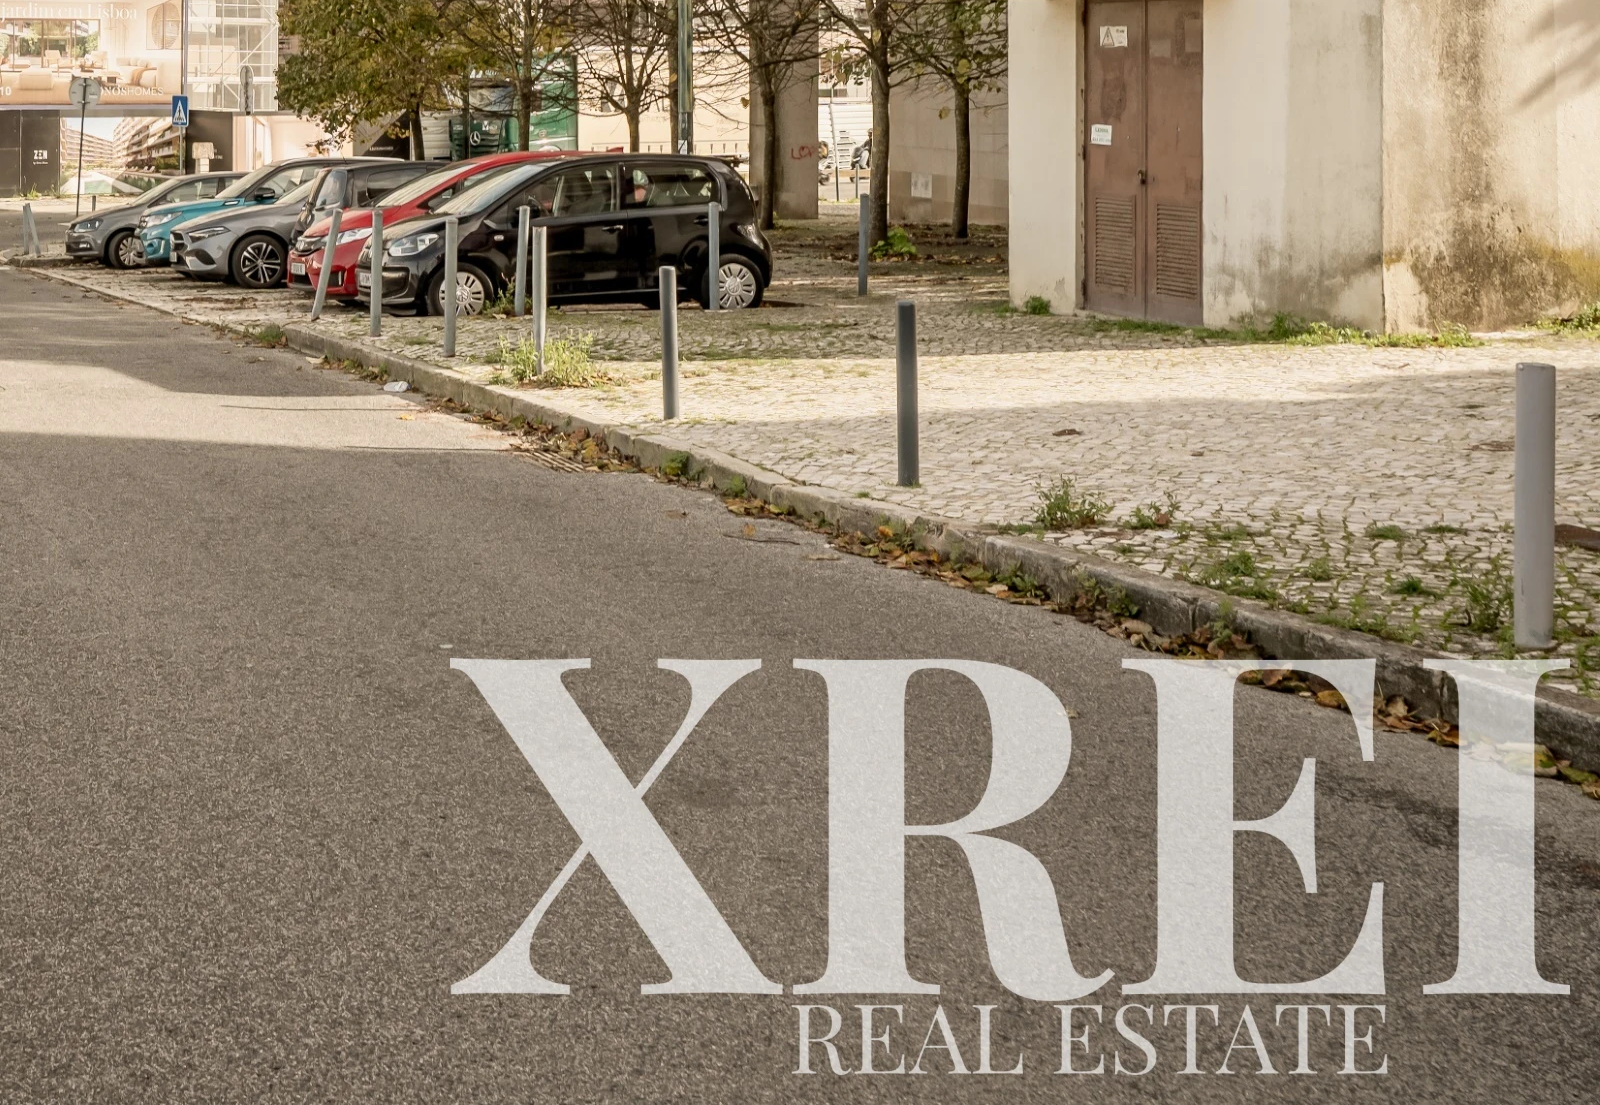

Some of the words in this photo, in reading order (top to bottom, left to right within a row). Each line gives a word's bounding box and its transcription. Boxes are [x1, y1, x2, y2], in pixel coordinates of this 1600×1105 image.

[0, 2, 54, 23] jardim
[58, 6, 83, 19] em
[88, 3, 137, 20] Lisboa
[99, 85, 165, 97] NOSHOMES
[33, 150, 48, 160] ZEN
